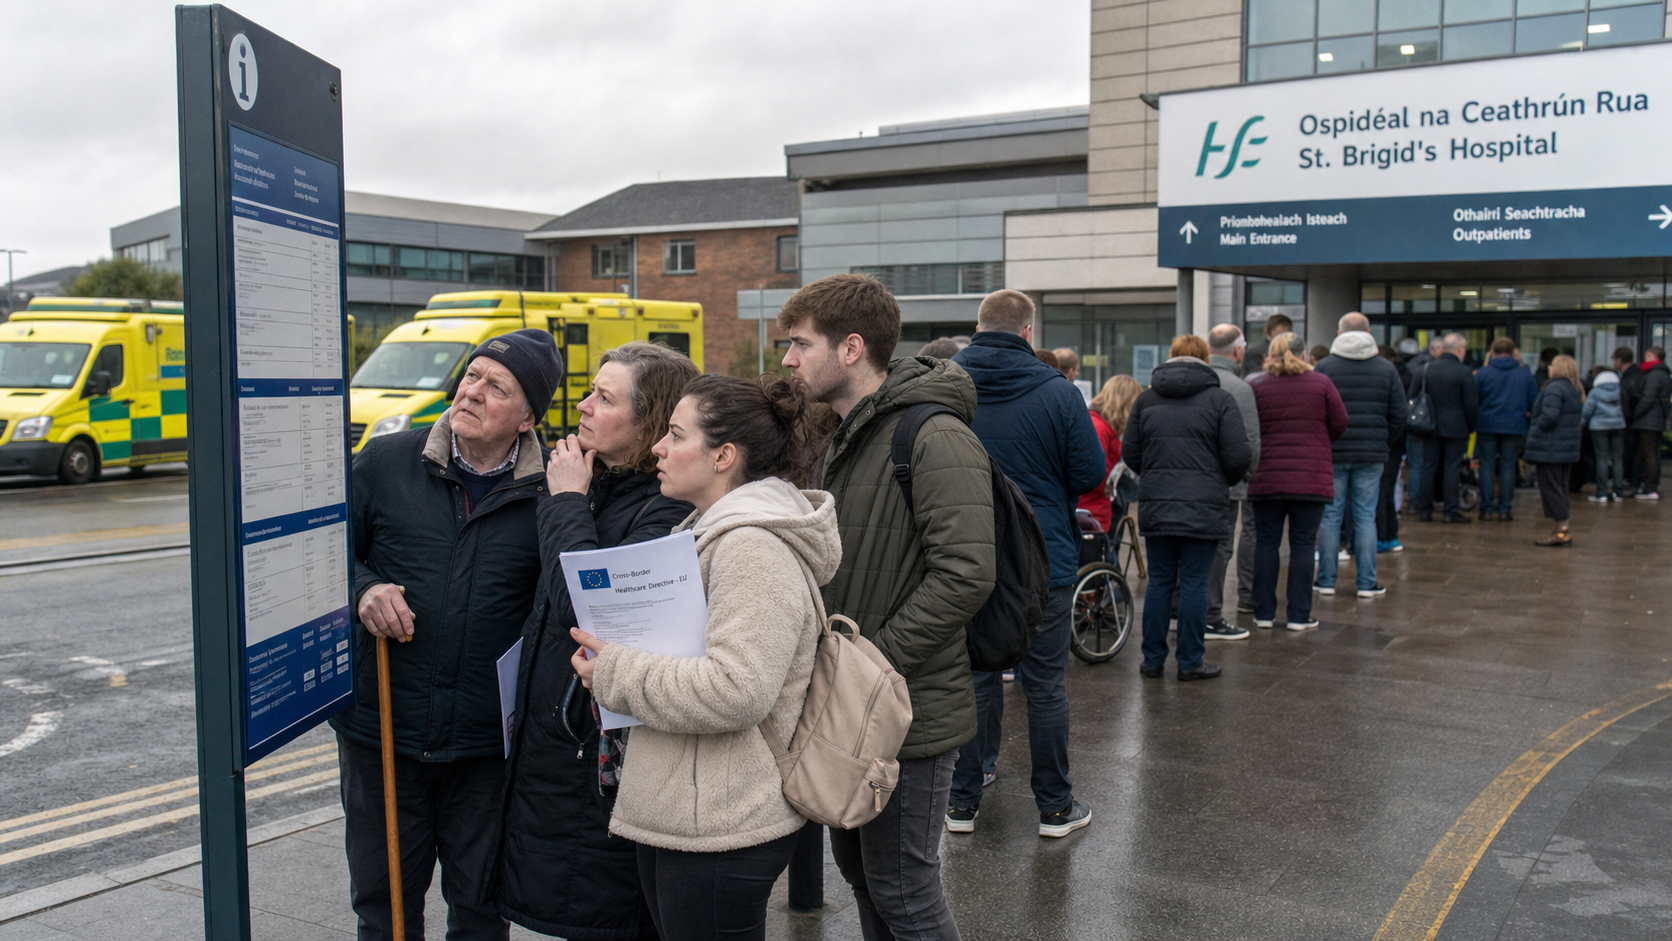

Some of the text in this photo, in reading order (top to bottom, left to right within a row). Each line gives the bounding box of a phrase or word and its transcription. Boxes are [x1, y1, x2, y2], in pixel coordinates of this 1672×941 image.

[1299, 90, 1649, 139] Ospidéal na Ceathrún Rua
[1299, 131, 1558, 170] St. Brigid's Hospital
[1306, 212, 1347, 226] Isteach
[1504, 204, 1586, 220] Seachtracha
[1220, 232, 1298, 246] Main Entrance
[1453, 227, 1532, 244] Outpatients
[612, 569, 651, 580] Cross-Border
[679, 574, 688, 583] EU
